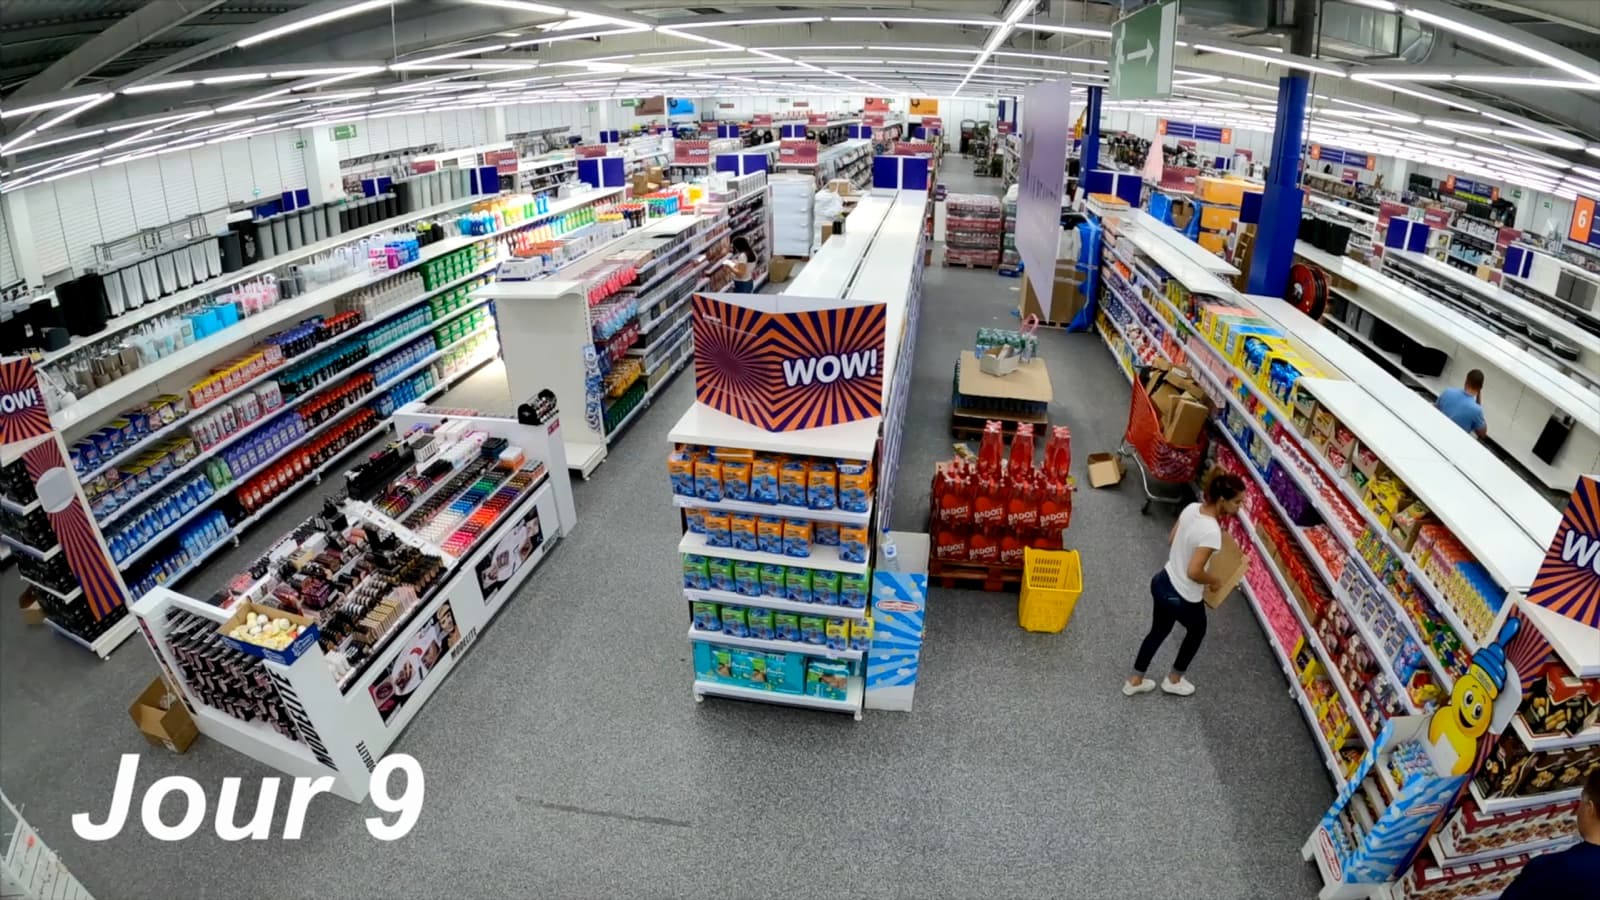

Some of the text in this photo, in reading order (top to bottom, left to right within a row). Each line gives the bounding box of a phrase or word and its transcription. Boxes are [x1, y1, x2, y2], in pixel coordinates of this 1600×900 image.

[1578, 209, 1588, 229] 6
[782, 348, 878, 387] WOW!
[0, 387, 39, 413] OW!
[974, 507, 1003, 519] BADOIT
[1008, 510, 1038, 521] BADOIT
[1040, 511, 1069, 522] BADOIT
[1001, 548, 1024, 559] BADO
[270, 667, 340, 773] MODELITE
